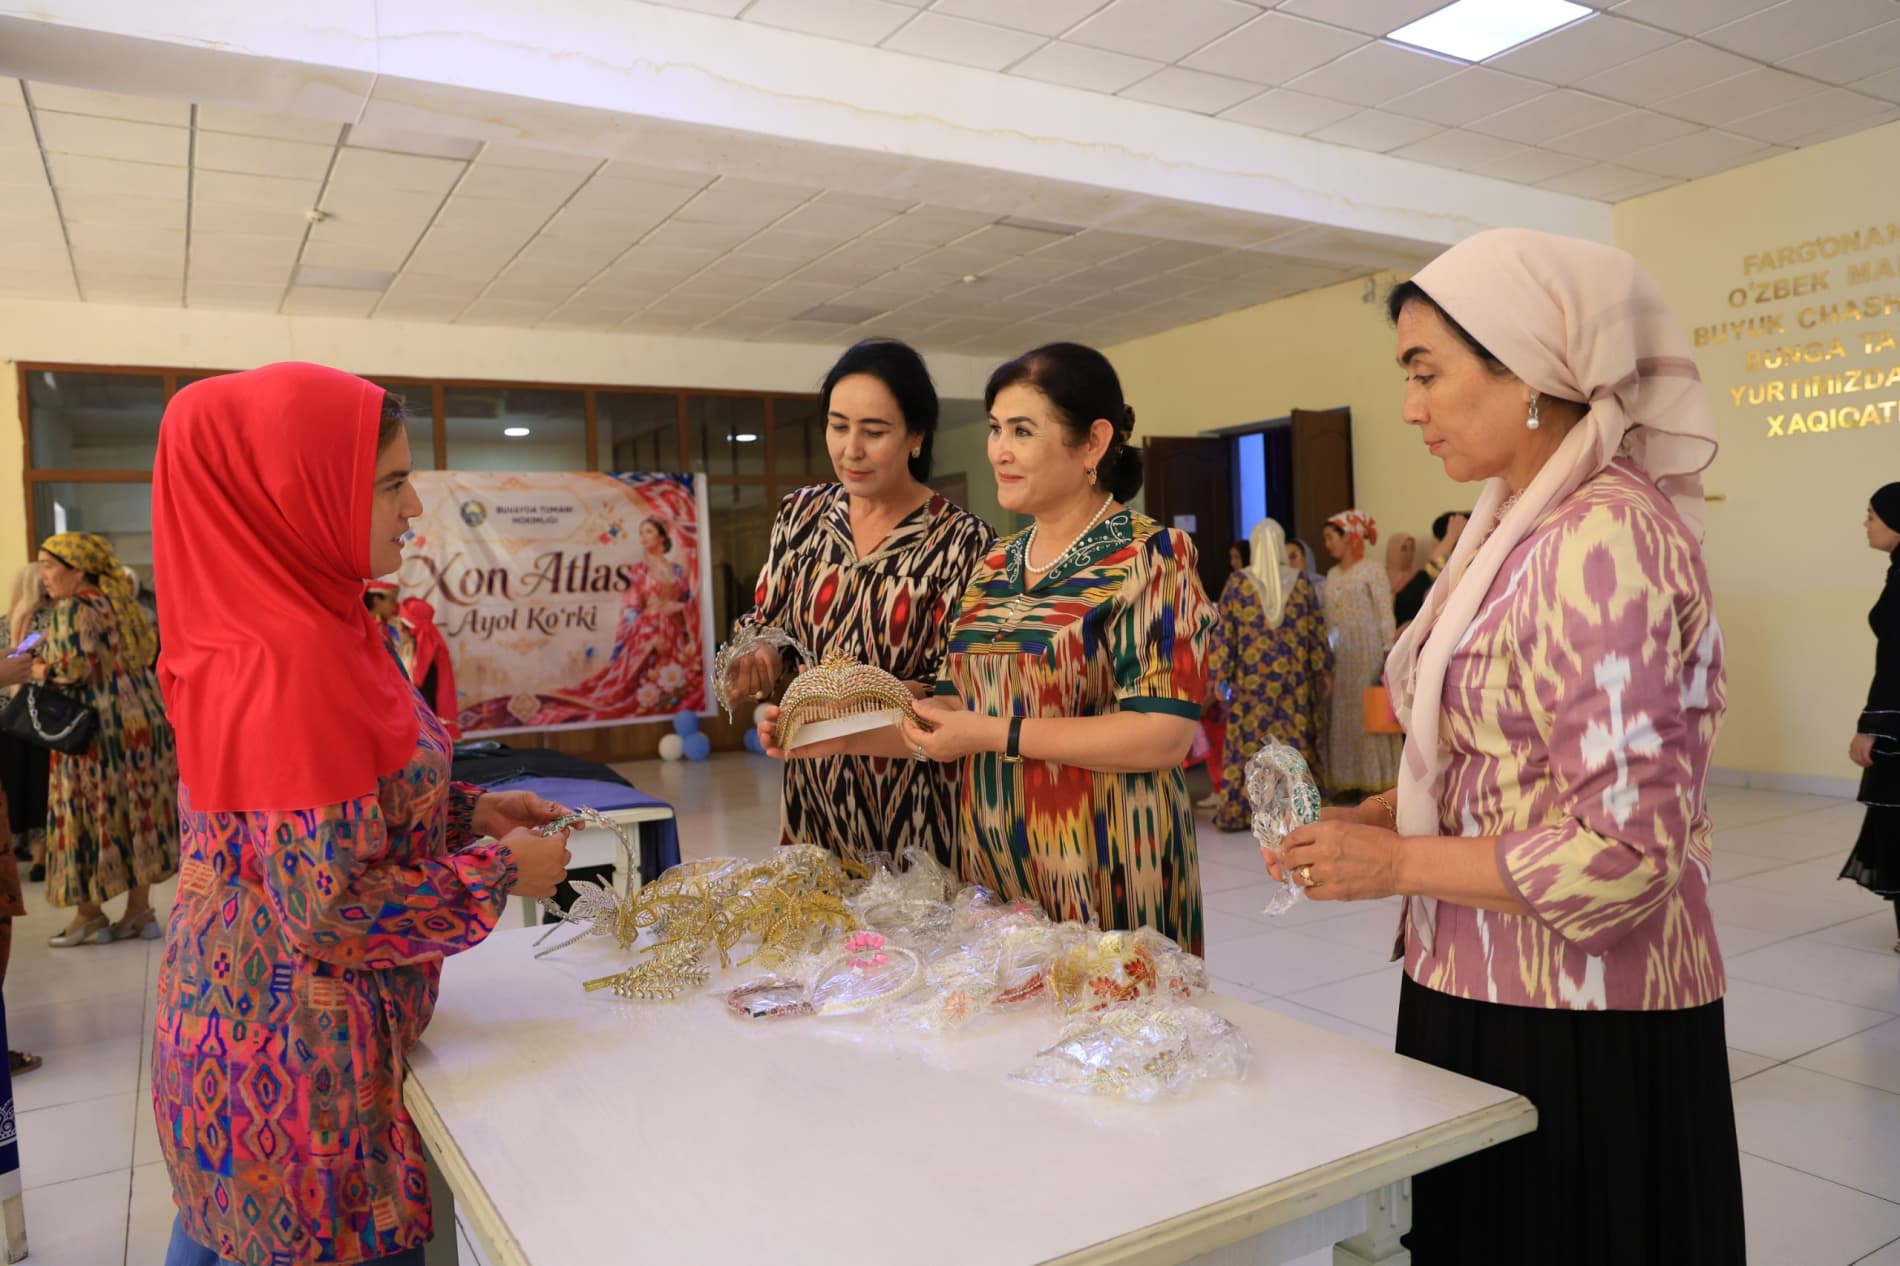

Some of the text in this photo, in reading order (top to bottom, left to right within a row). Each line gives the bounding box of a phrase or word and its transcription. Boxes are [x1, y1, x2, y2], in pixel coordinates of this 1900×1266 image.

[1693, 312, 1786, 348] BUYUK
[1766, 399, 1900, 438] XAQIQAT
[400, 551, 632, 607] Xon Atlas
[448, 608, 518, 640] Ayol
